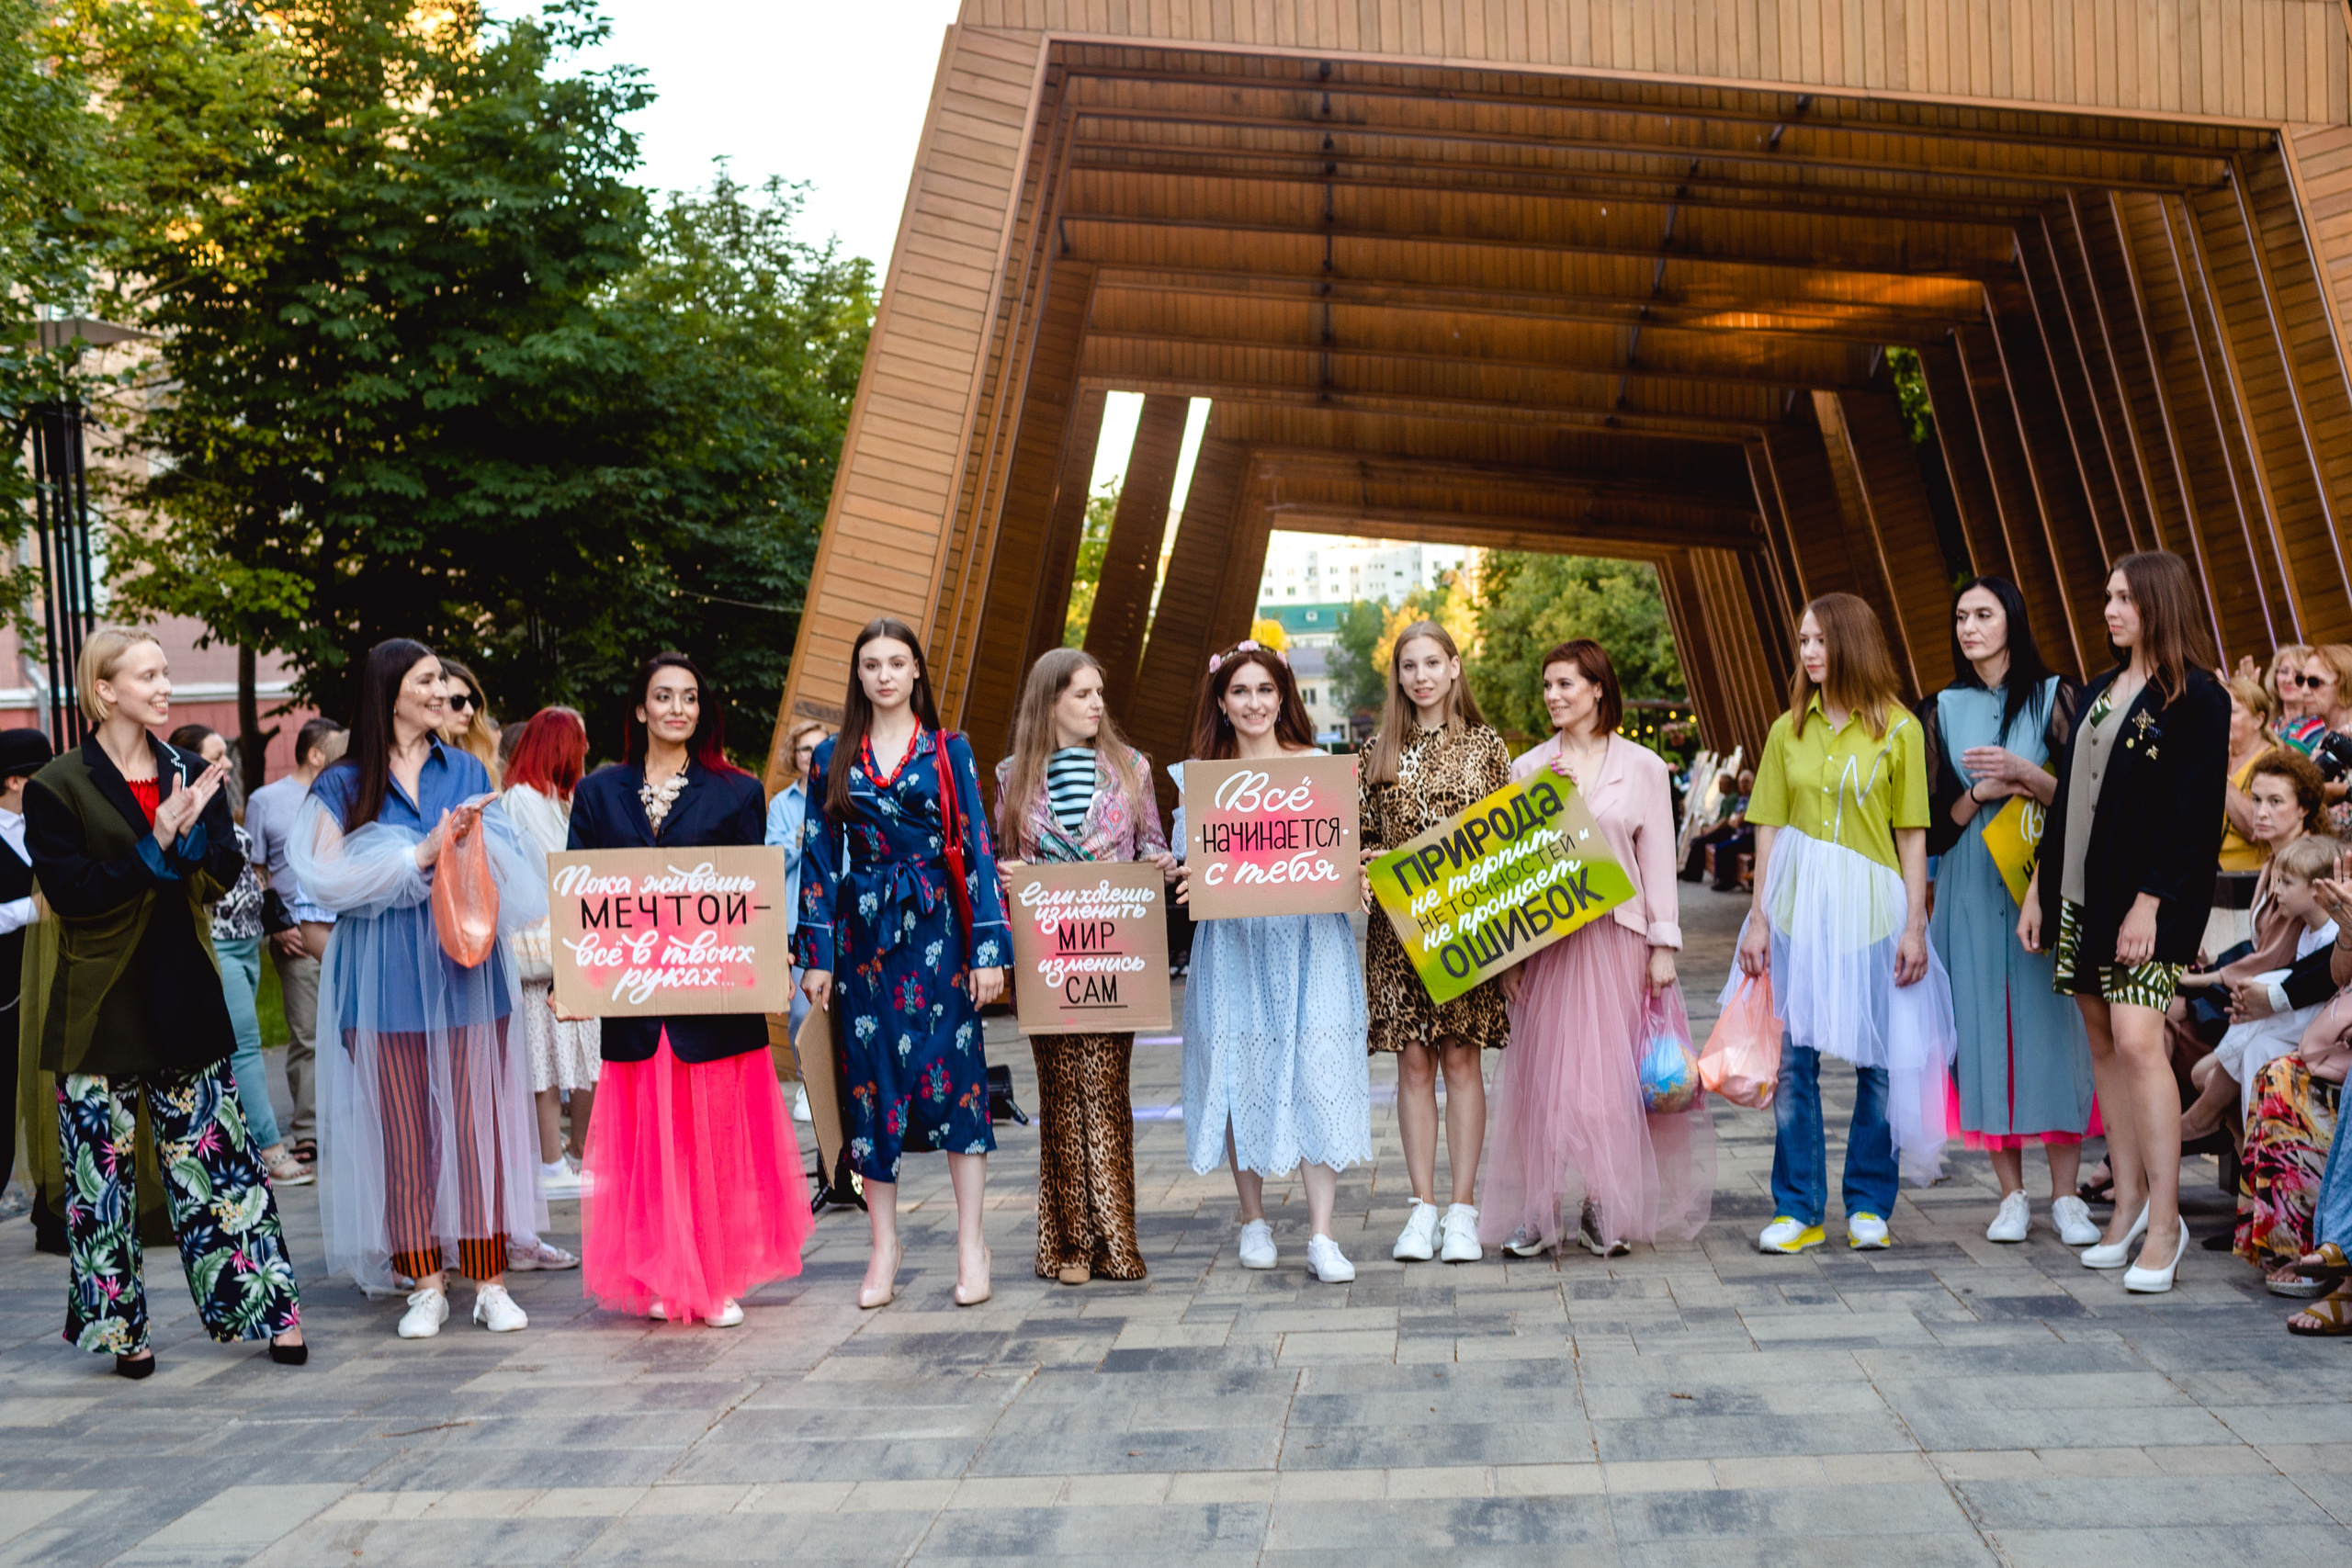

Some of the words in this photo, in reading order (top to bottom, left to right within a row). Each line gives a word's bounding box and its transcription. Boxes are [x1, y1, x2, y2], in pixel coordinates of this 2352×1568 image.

[1215, 770, 1314, 812] Всё
[553, 864, 631, 897] Пока
[639, 862, 756, 893] живёшь
[1204, 863, 1228, 886] с
[1233, 850, 1340, 885] тебя
[1410, 889, 1442, 918] не
[1447, 829, 1563, 896] терпит
[1018, 881, 1076, 907] Если
[1076, 879, 1156, 904] хочешь
[1423, 923, 1453, 953] не
[1457, 860, 1582, 936] прощает
[1035, 904, 1147, 935] изменить
[1058, 921, 1115, 951] МИР
[1440, 866, 1605, 978] ОШИБОК
[661, 930, 755, 965] твоих
[1038, 956, 1146, 987] изменись
[1066, 975, 1118, 1004] САМ
